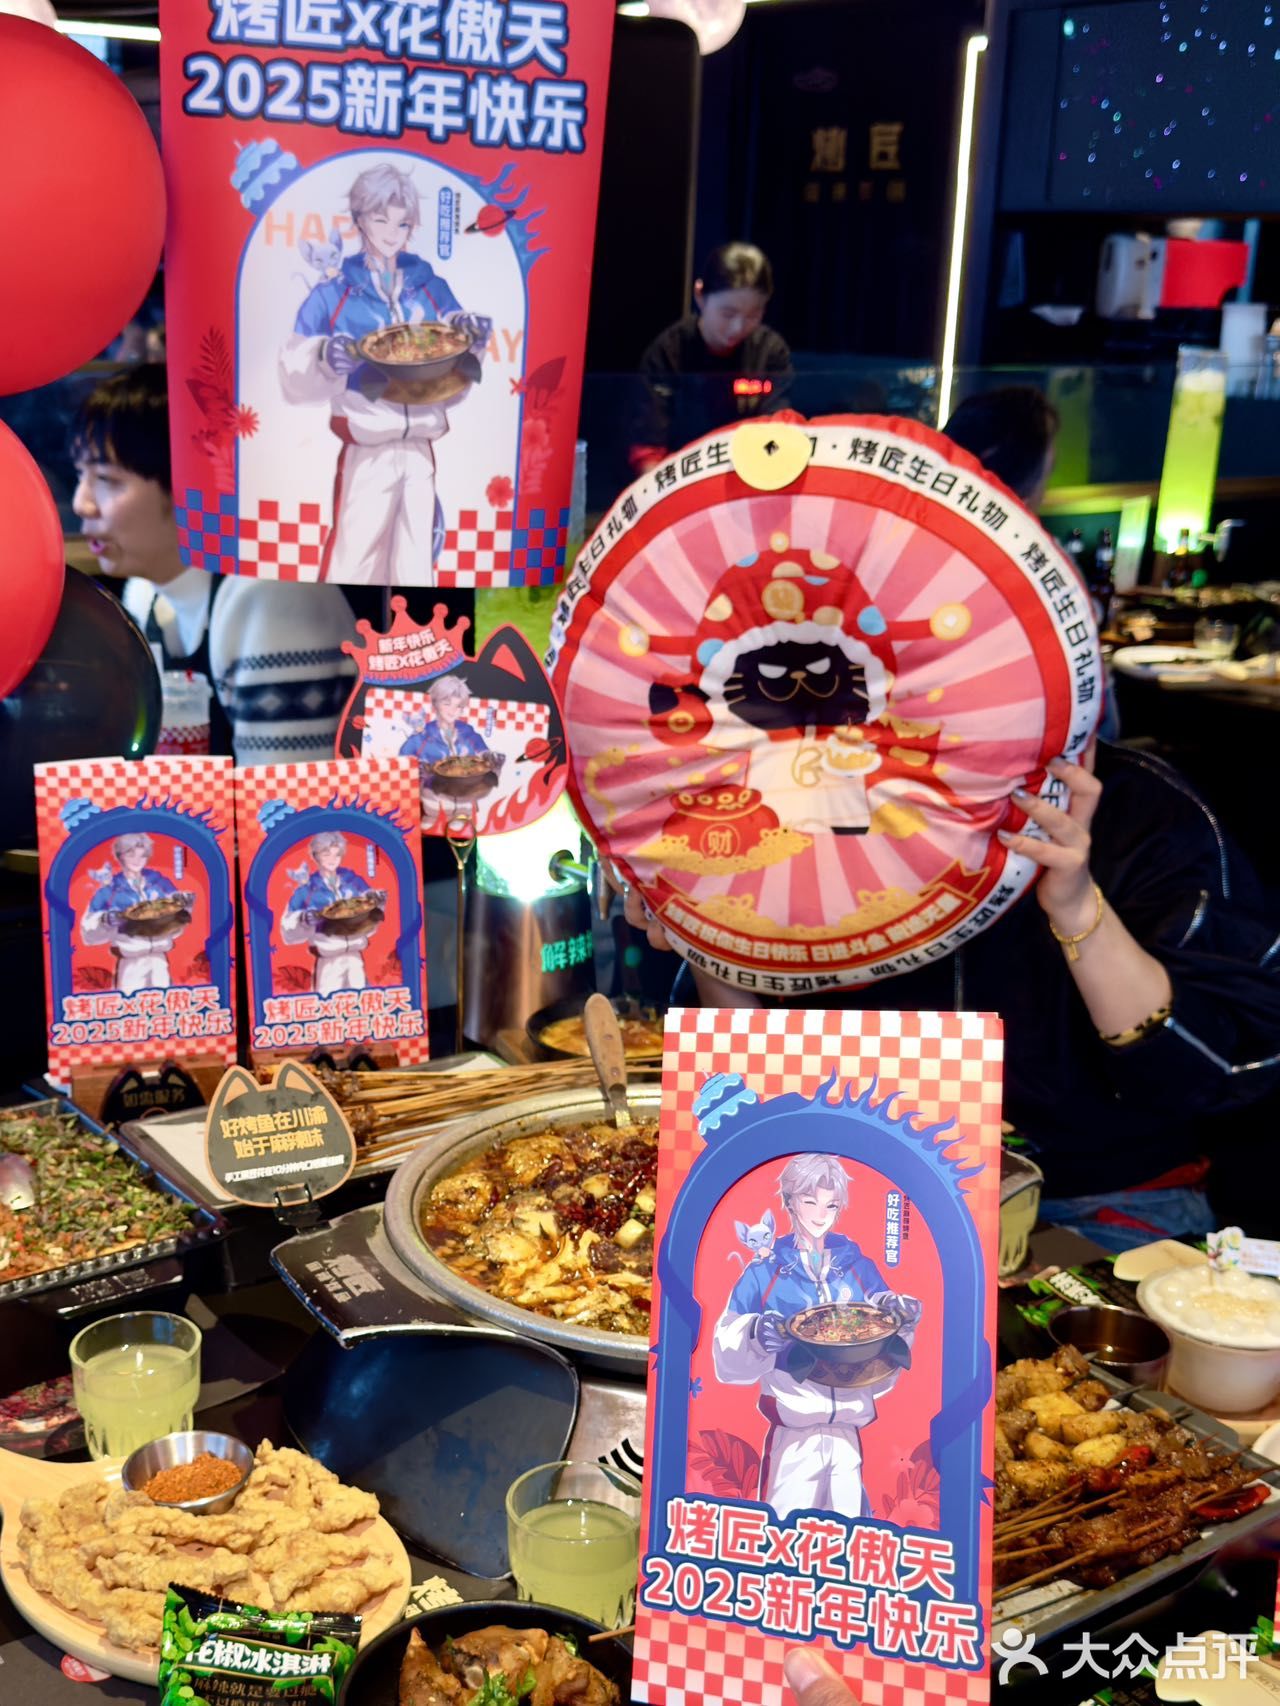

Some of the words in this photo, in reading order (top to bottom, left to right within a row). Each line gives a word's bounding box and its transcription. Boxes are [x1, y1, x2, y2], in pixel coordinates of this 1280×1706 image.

[186, 55, 587, 150] 2025新年快乐
[848, 435, 1009, 531] 烤匠生日礼物
[378, 628, 435, 653] 新年快乐
[1019, 541, 1097, 706] 烤匠生日礼物
[708, 829, 733, 855] 财
[52, 1009, 232, 1044] 2025新年快乐
[254, 1010, 424, 1048] 2025新年快乐
[886, 1193, 900, 1263] 好吃推荐官
[664, 1497, 956, 1601] 烤匠x花傲天
[643, 1556, 981, 1666] 2025新年快乐
